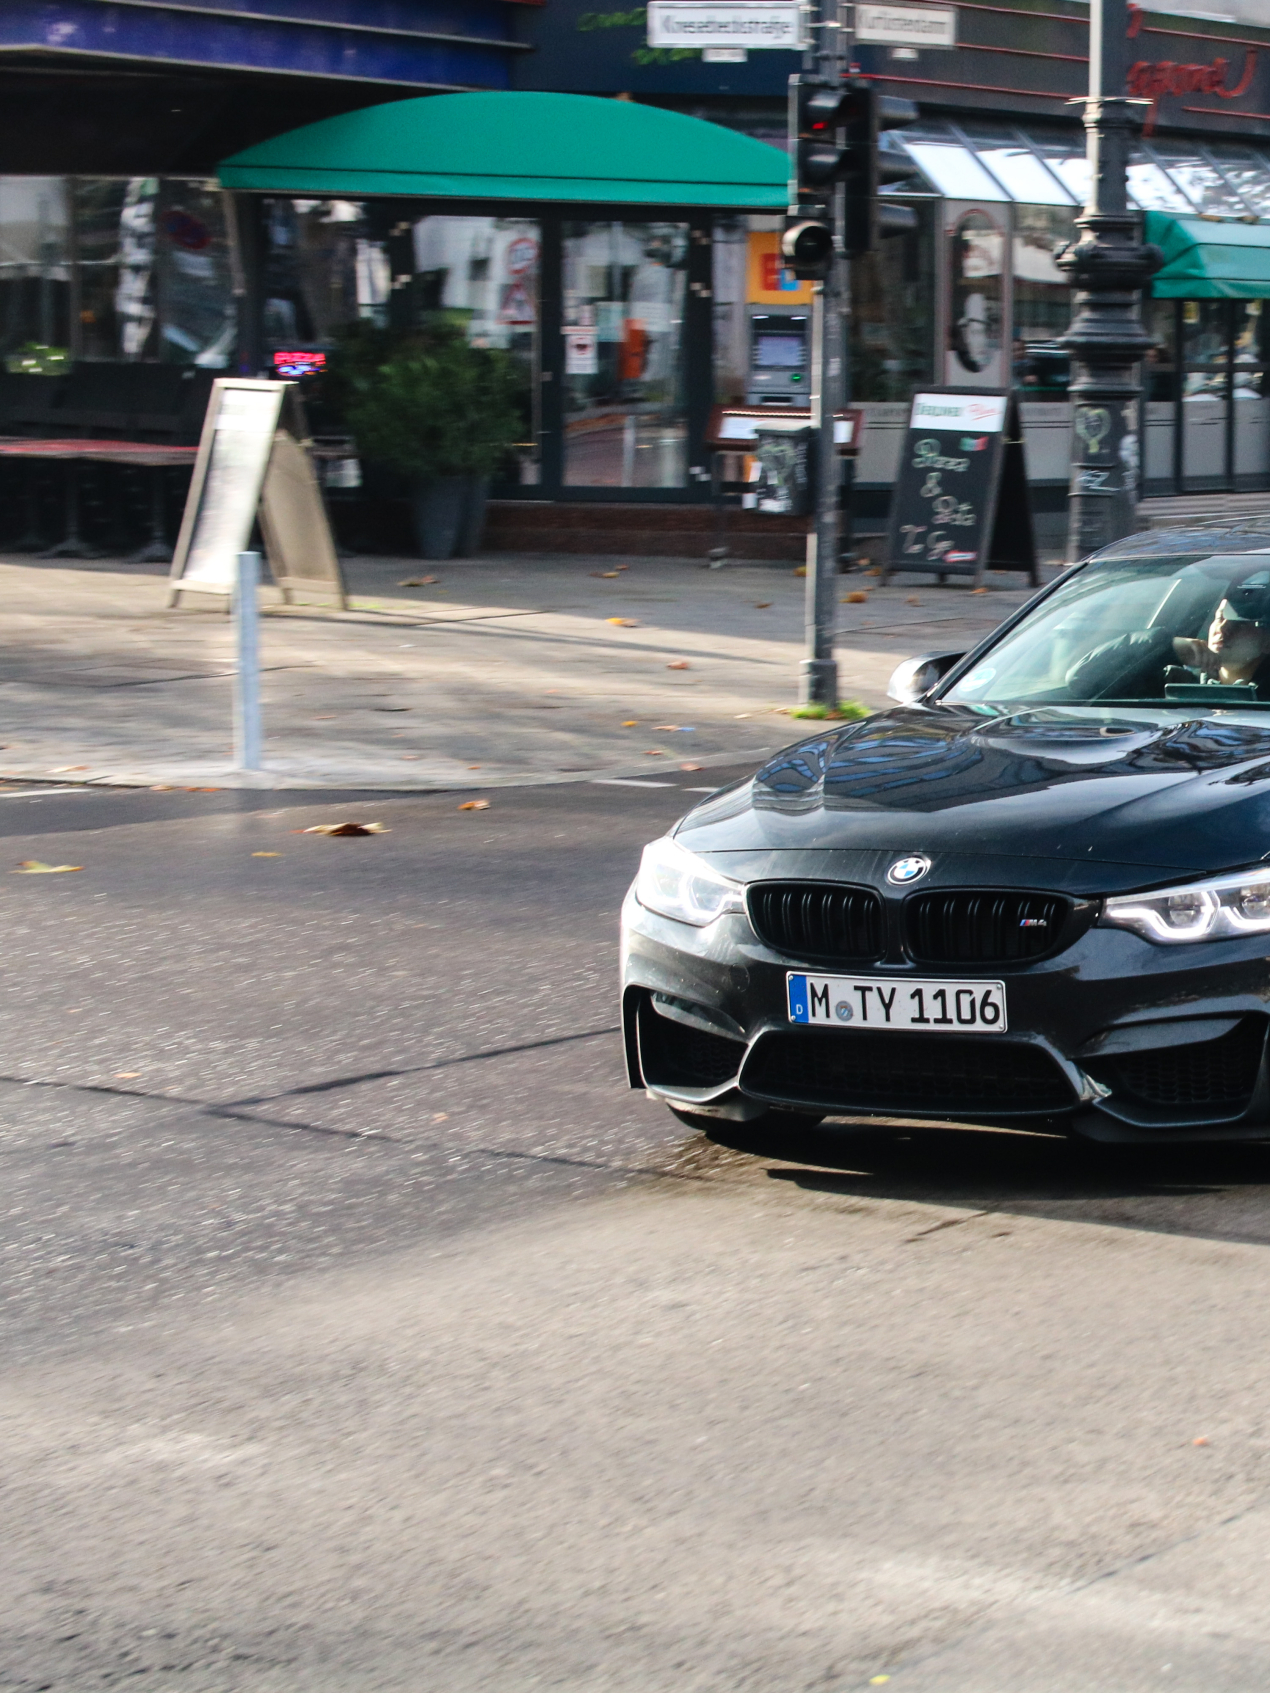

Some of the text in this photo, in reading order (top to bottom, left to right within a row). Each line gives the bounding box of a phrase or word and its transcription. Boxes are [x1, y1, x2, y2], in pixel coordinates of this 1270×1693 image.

[1021, 918, 1048, 928] M4
[809, 981, 1001, 1026] M TY 1106
[795, 1004, 804, 1015] D
